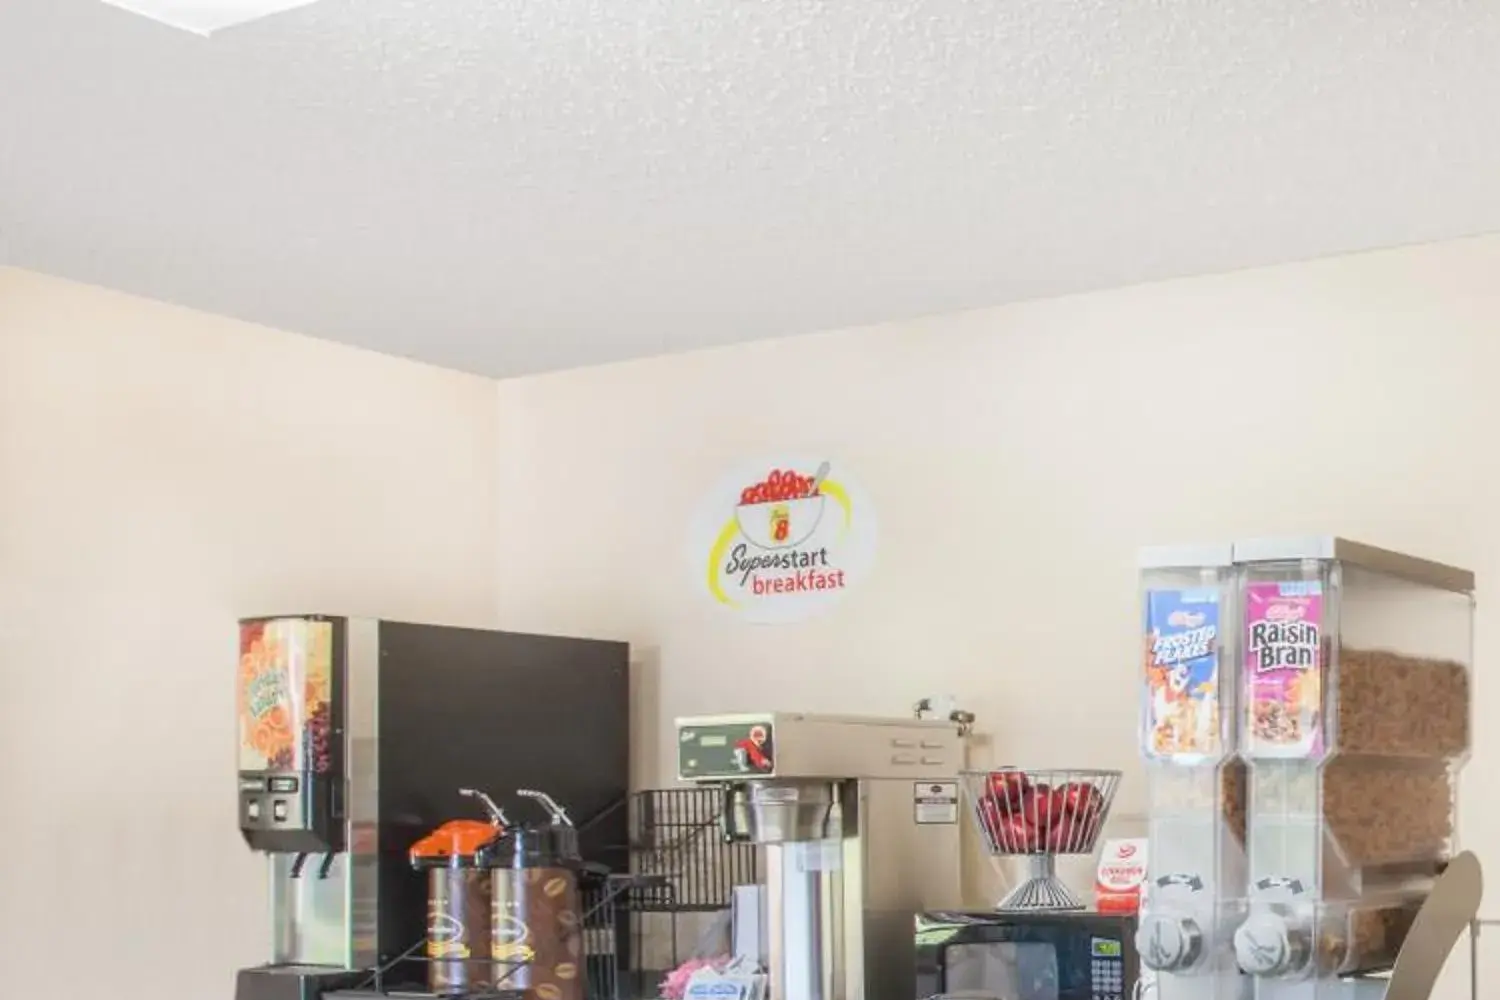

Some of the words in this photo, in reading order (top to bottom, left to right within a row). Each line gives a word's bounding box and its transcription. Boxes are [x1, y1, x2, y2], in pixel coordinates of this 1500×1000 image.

[725, 543, 828, 587] Superstart
[753, 569, 845, 595] breakfast
[1252, 623, 1317, 648] Raisin
[1260, 645, 1311, 668] Bran
